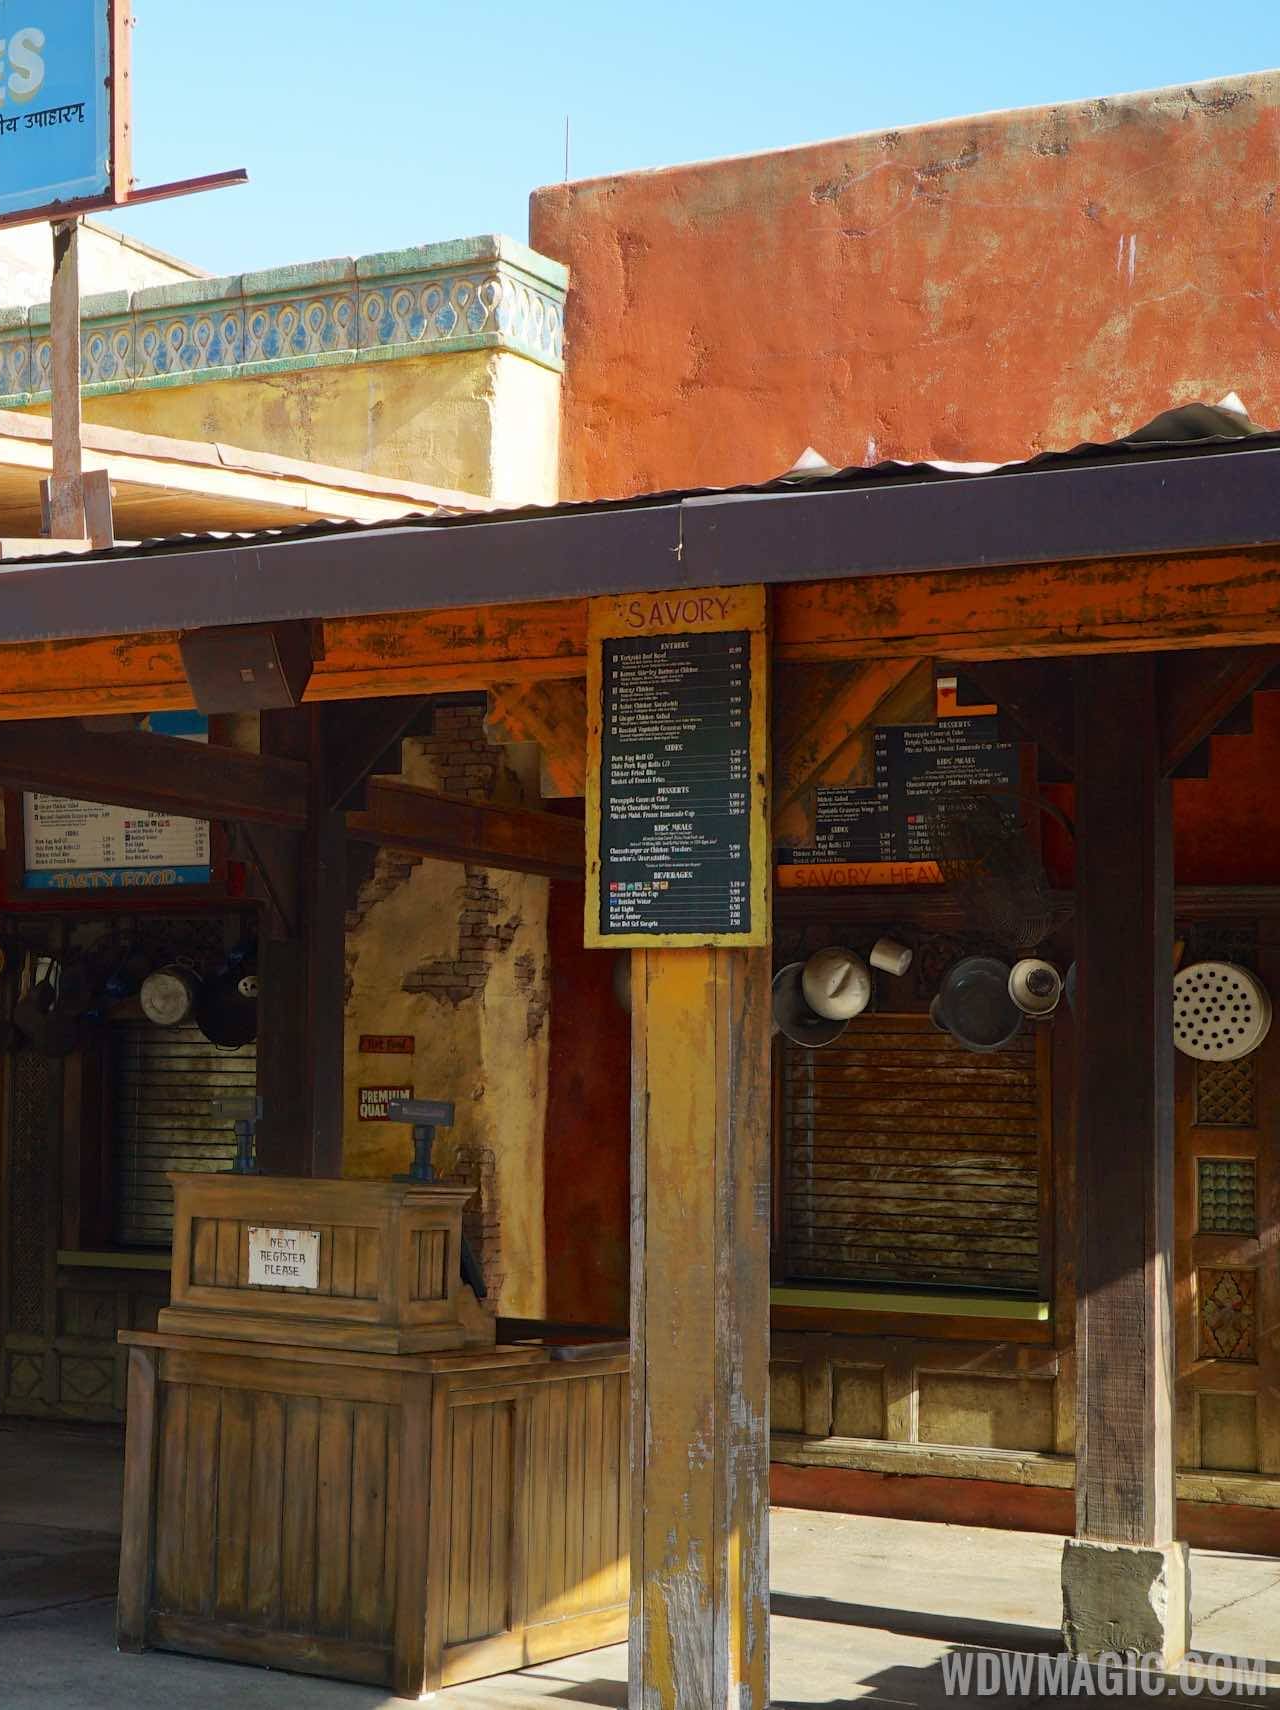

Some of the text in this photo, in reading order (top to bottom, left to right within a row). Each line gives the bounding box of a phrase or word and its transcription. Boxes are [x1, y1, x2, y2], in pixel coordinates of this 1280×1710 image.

[625, 597, 730, 628] SAVORY
[794, 867, 873, 887] SAVORY
[362, 1089, 410, 1104] PREMIUM
[360, 1103, 391, 1118] QUAL
[270, 1238, 297, 1250] NEXT
[260, 1250, 306, 1264] REGISTER
[264, 1264, 300, 1277] PLEASE
